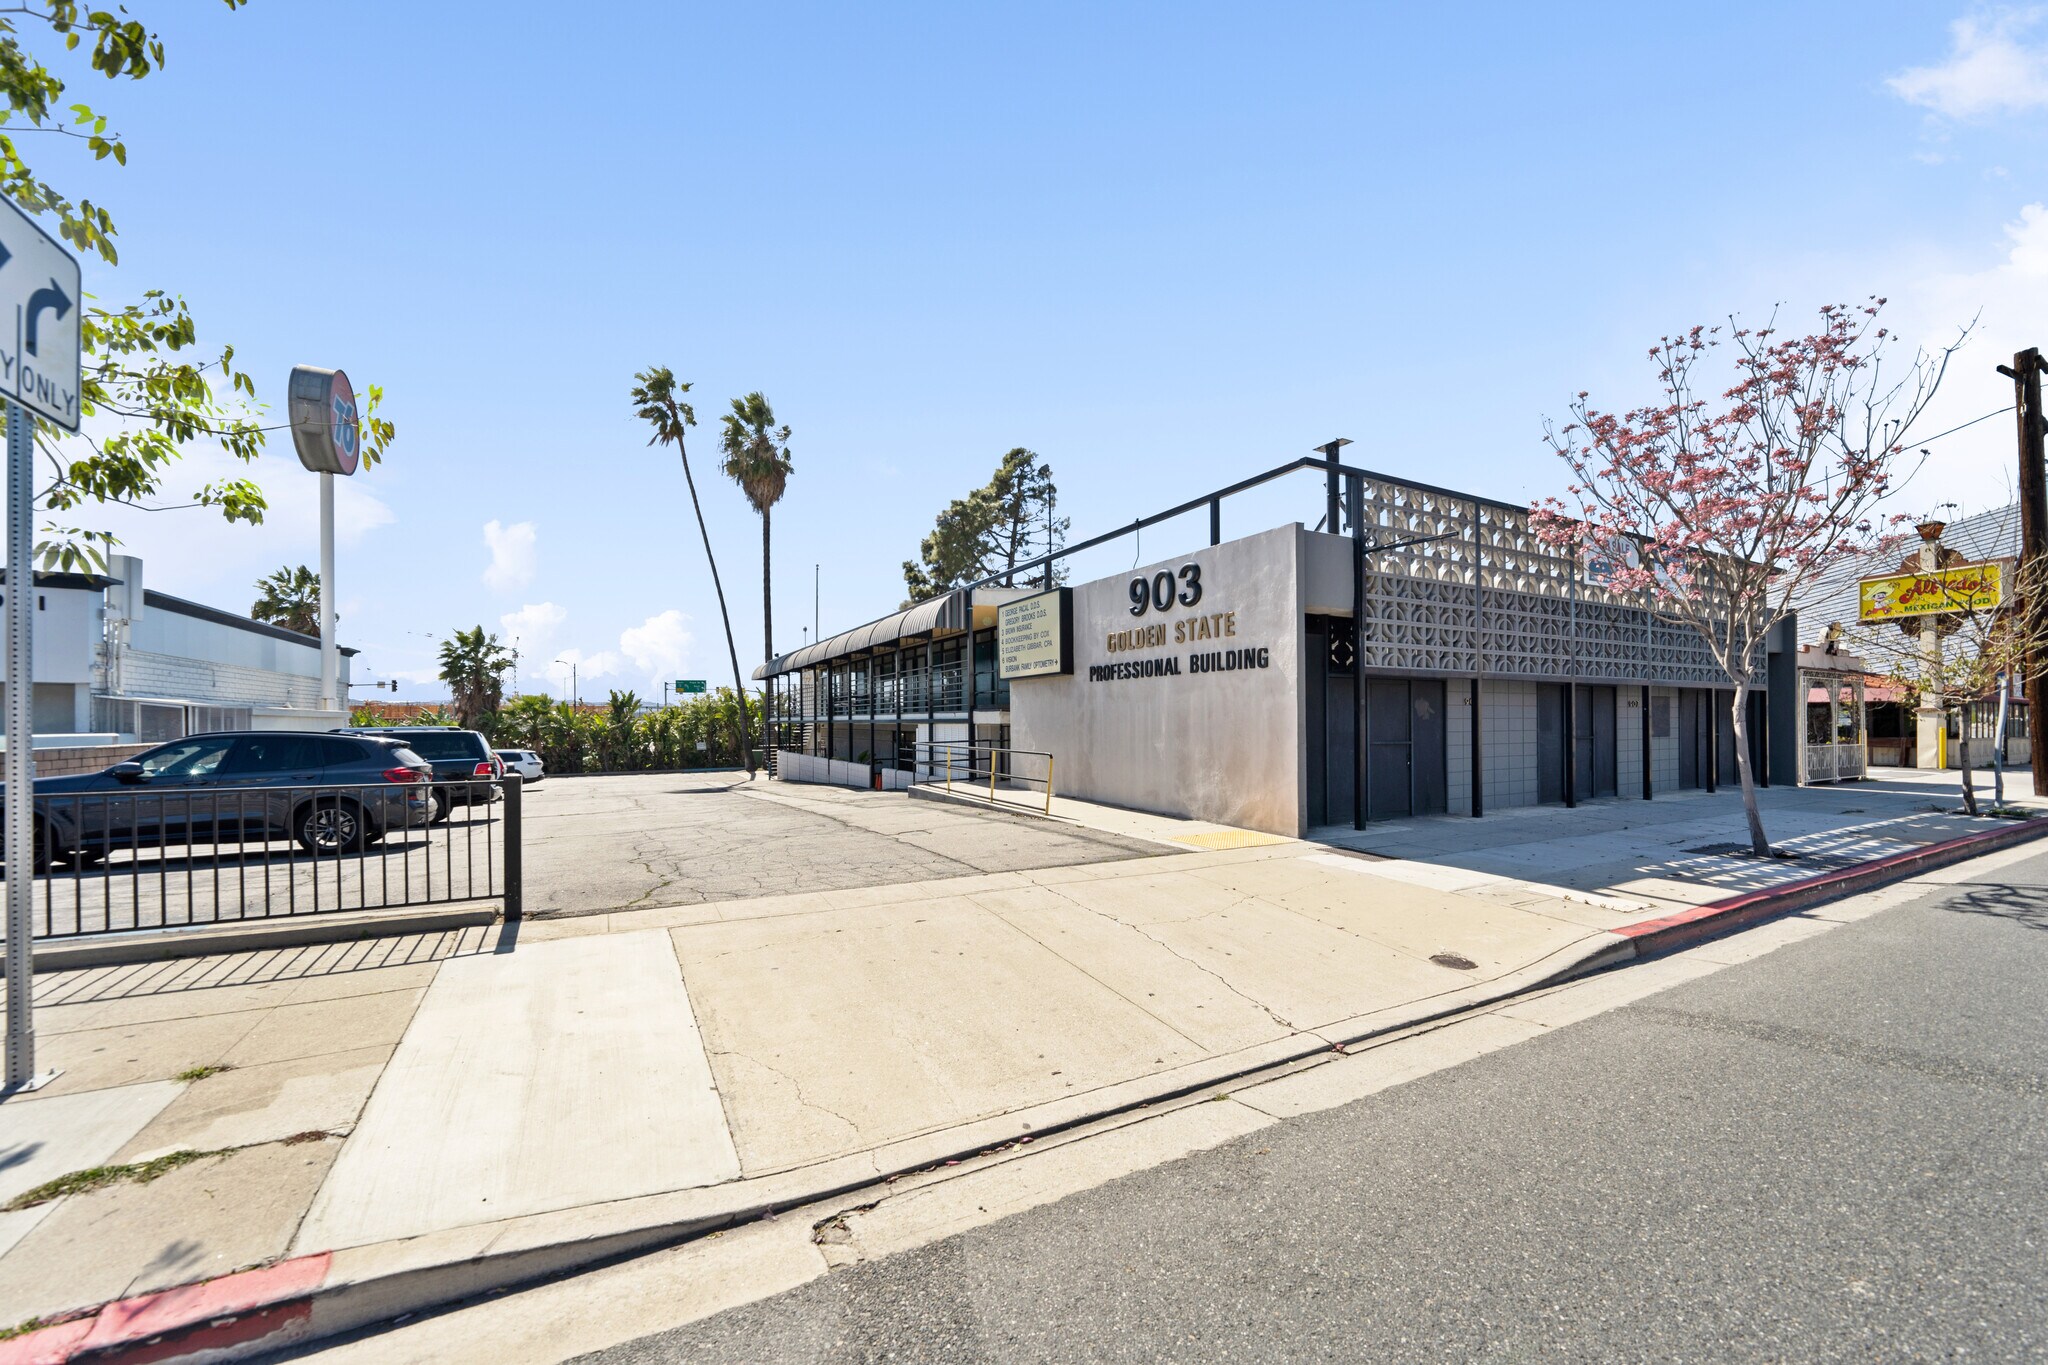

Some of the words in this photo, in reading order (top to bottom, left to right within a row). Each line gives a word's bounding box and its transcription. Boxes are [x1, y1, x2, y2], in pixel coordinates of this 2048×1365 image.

[22, 365, 75, 416] ONLY
[1129, 561, 1202, 617] 903
[1899, 576, 1994, 604] Alfedo's
[1904, 602, 1953, 612] MEXICAN
[1106, 623, 1166, 653] GOLDEN
[1174, 611, 1235, 644] STATE
[1089, 656, 1181, 682] PROFESSIONAL
[1189, 647, 1269, 674] BUILDING
